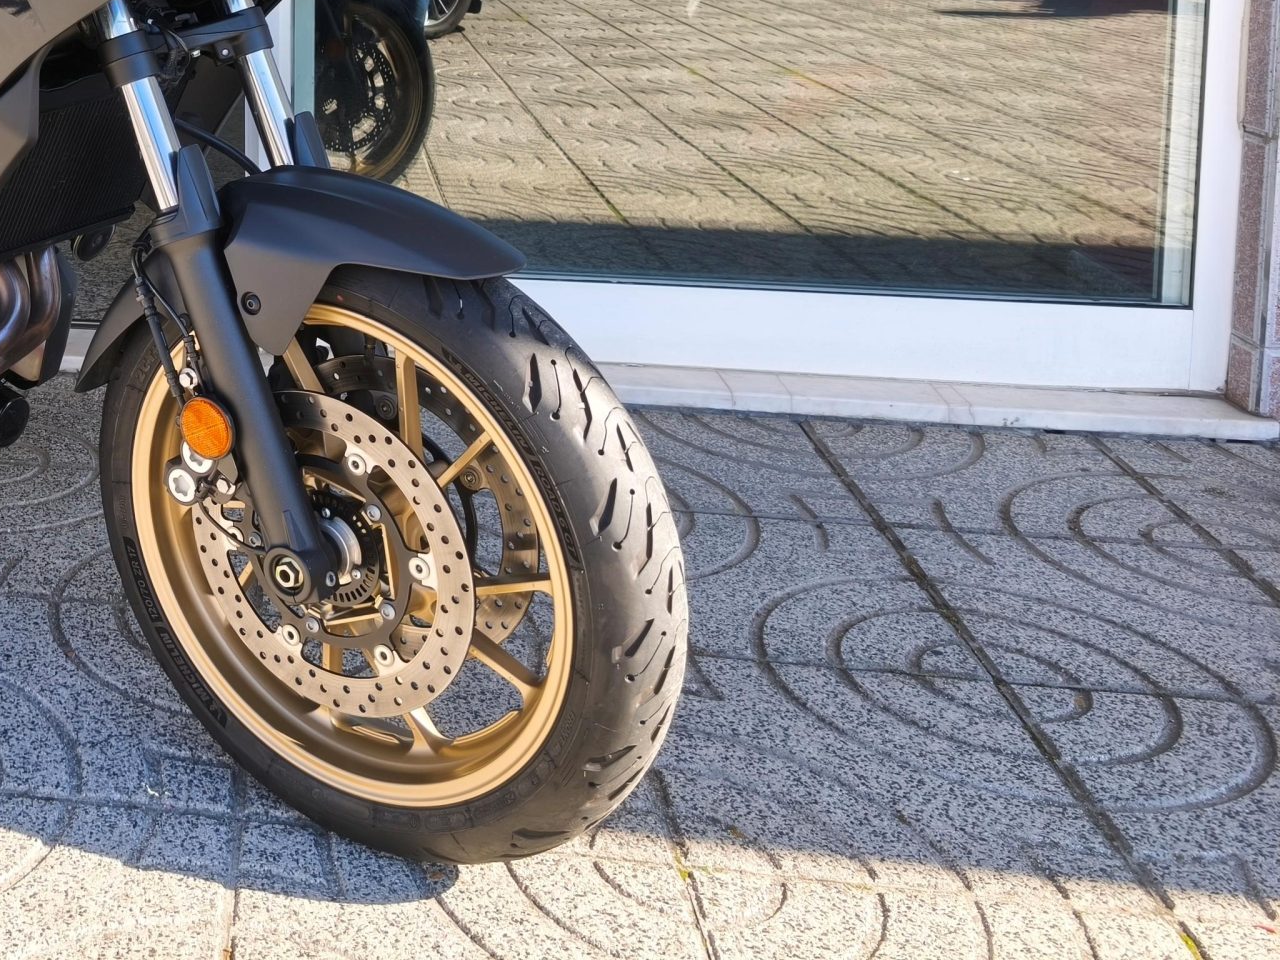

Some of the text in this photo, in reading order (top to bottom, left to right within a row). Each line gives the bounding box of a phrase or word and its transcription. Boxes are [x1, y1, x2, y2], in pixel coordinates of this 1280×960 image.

[464, 372, 529, 453] MICHELIN
[534, 464, 561, 516] ROAD
[564, 533, 577, 560] GT
[131, 559, 142, 578] ZR
[137, 579, 157, 621] 120/70
[160, 631, 214, 705] MICHELIN
